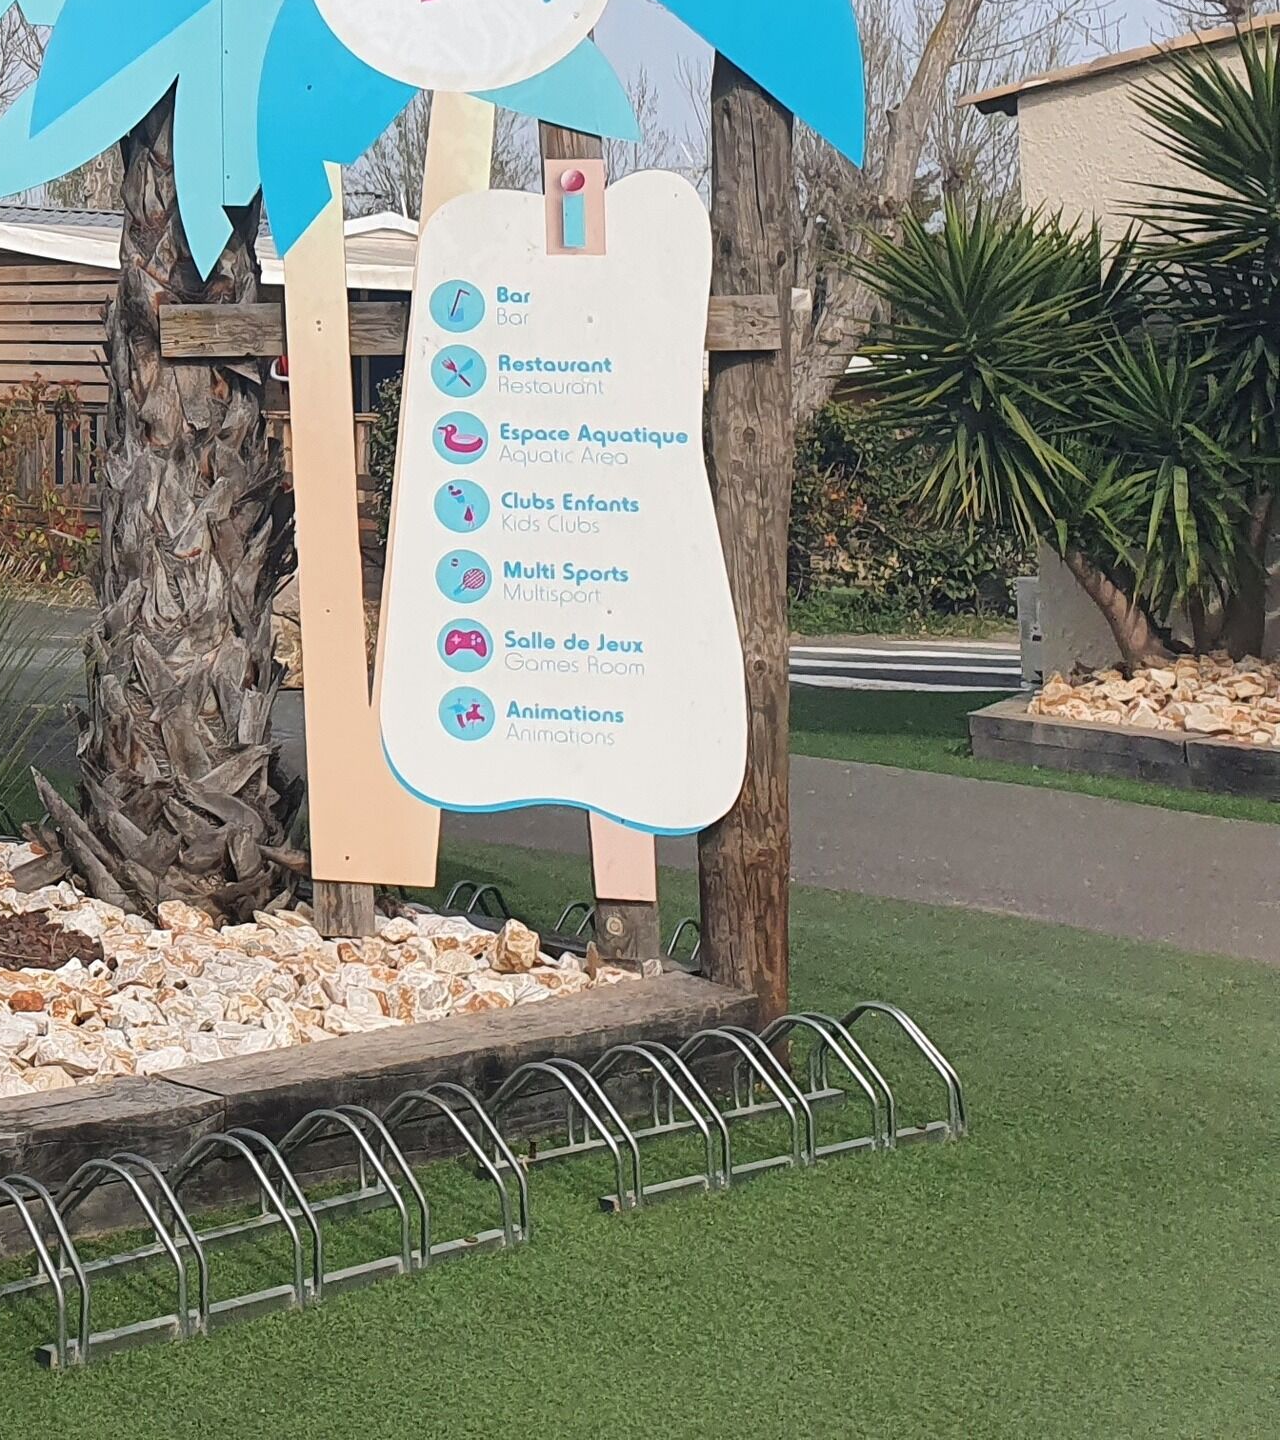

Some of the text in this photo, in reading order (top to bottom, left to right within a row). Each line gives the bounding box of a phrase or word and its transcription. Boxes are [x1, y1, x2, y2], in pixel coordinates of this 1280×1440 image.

[497, 286, 530, 303] Bar
[497, 308, 529, 325] Bar
[499, 355, 612, 373] Restaurant
[498, 376, 604, 395] Restaurant
[500, 423, 688, 449] Espace Aquatique
[499, 445, 628, 467] Aquatic Area
[501, 492, 639, 512] Clubs Enfants
[501, 515, 600, 533] Kids Clubs
[503, 561, 629, 585] Multi Sports
[503, 584, 601, 607] Multisport
[504, 631, 643, 653] Salle de Jeux
[504, 652, 645, 676] Games Room
[506, 701, 624, 723] Animations
[506, 723, 615, 746] Animations
